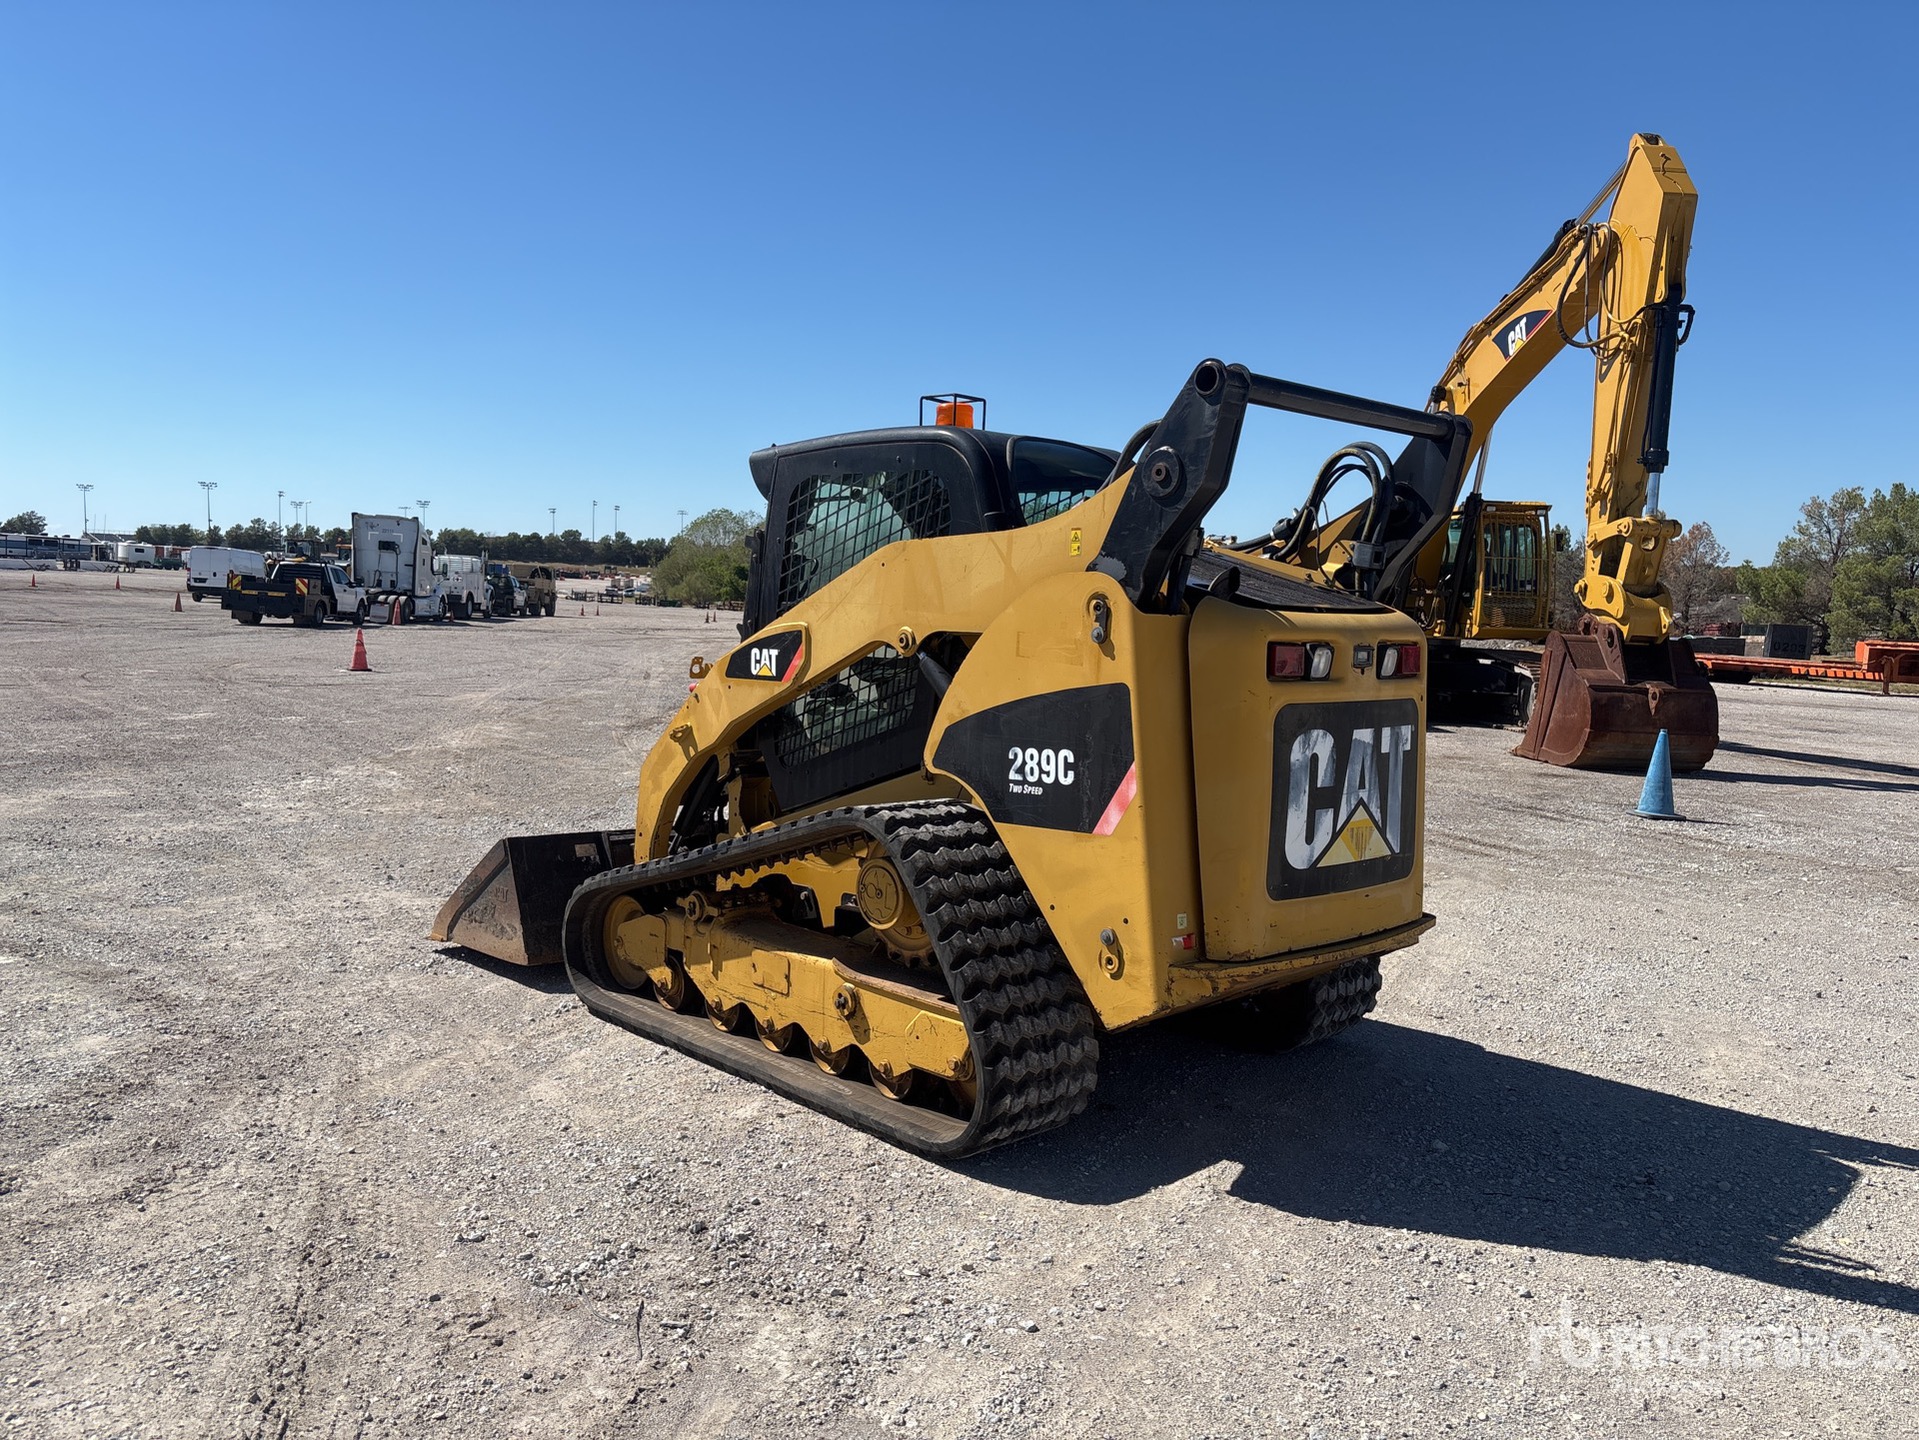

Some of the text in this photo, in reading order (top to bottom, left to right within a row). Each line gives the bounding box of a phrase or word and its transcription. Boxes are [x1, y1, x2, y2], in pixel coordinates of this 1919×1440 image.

[1508, 316, 1527, 356] CAT
[751, 647, 779, 677] CAT
[1008, 746, 1075, 786] 289C
[1284, 724, 1413, 870] CAT
